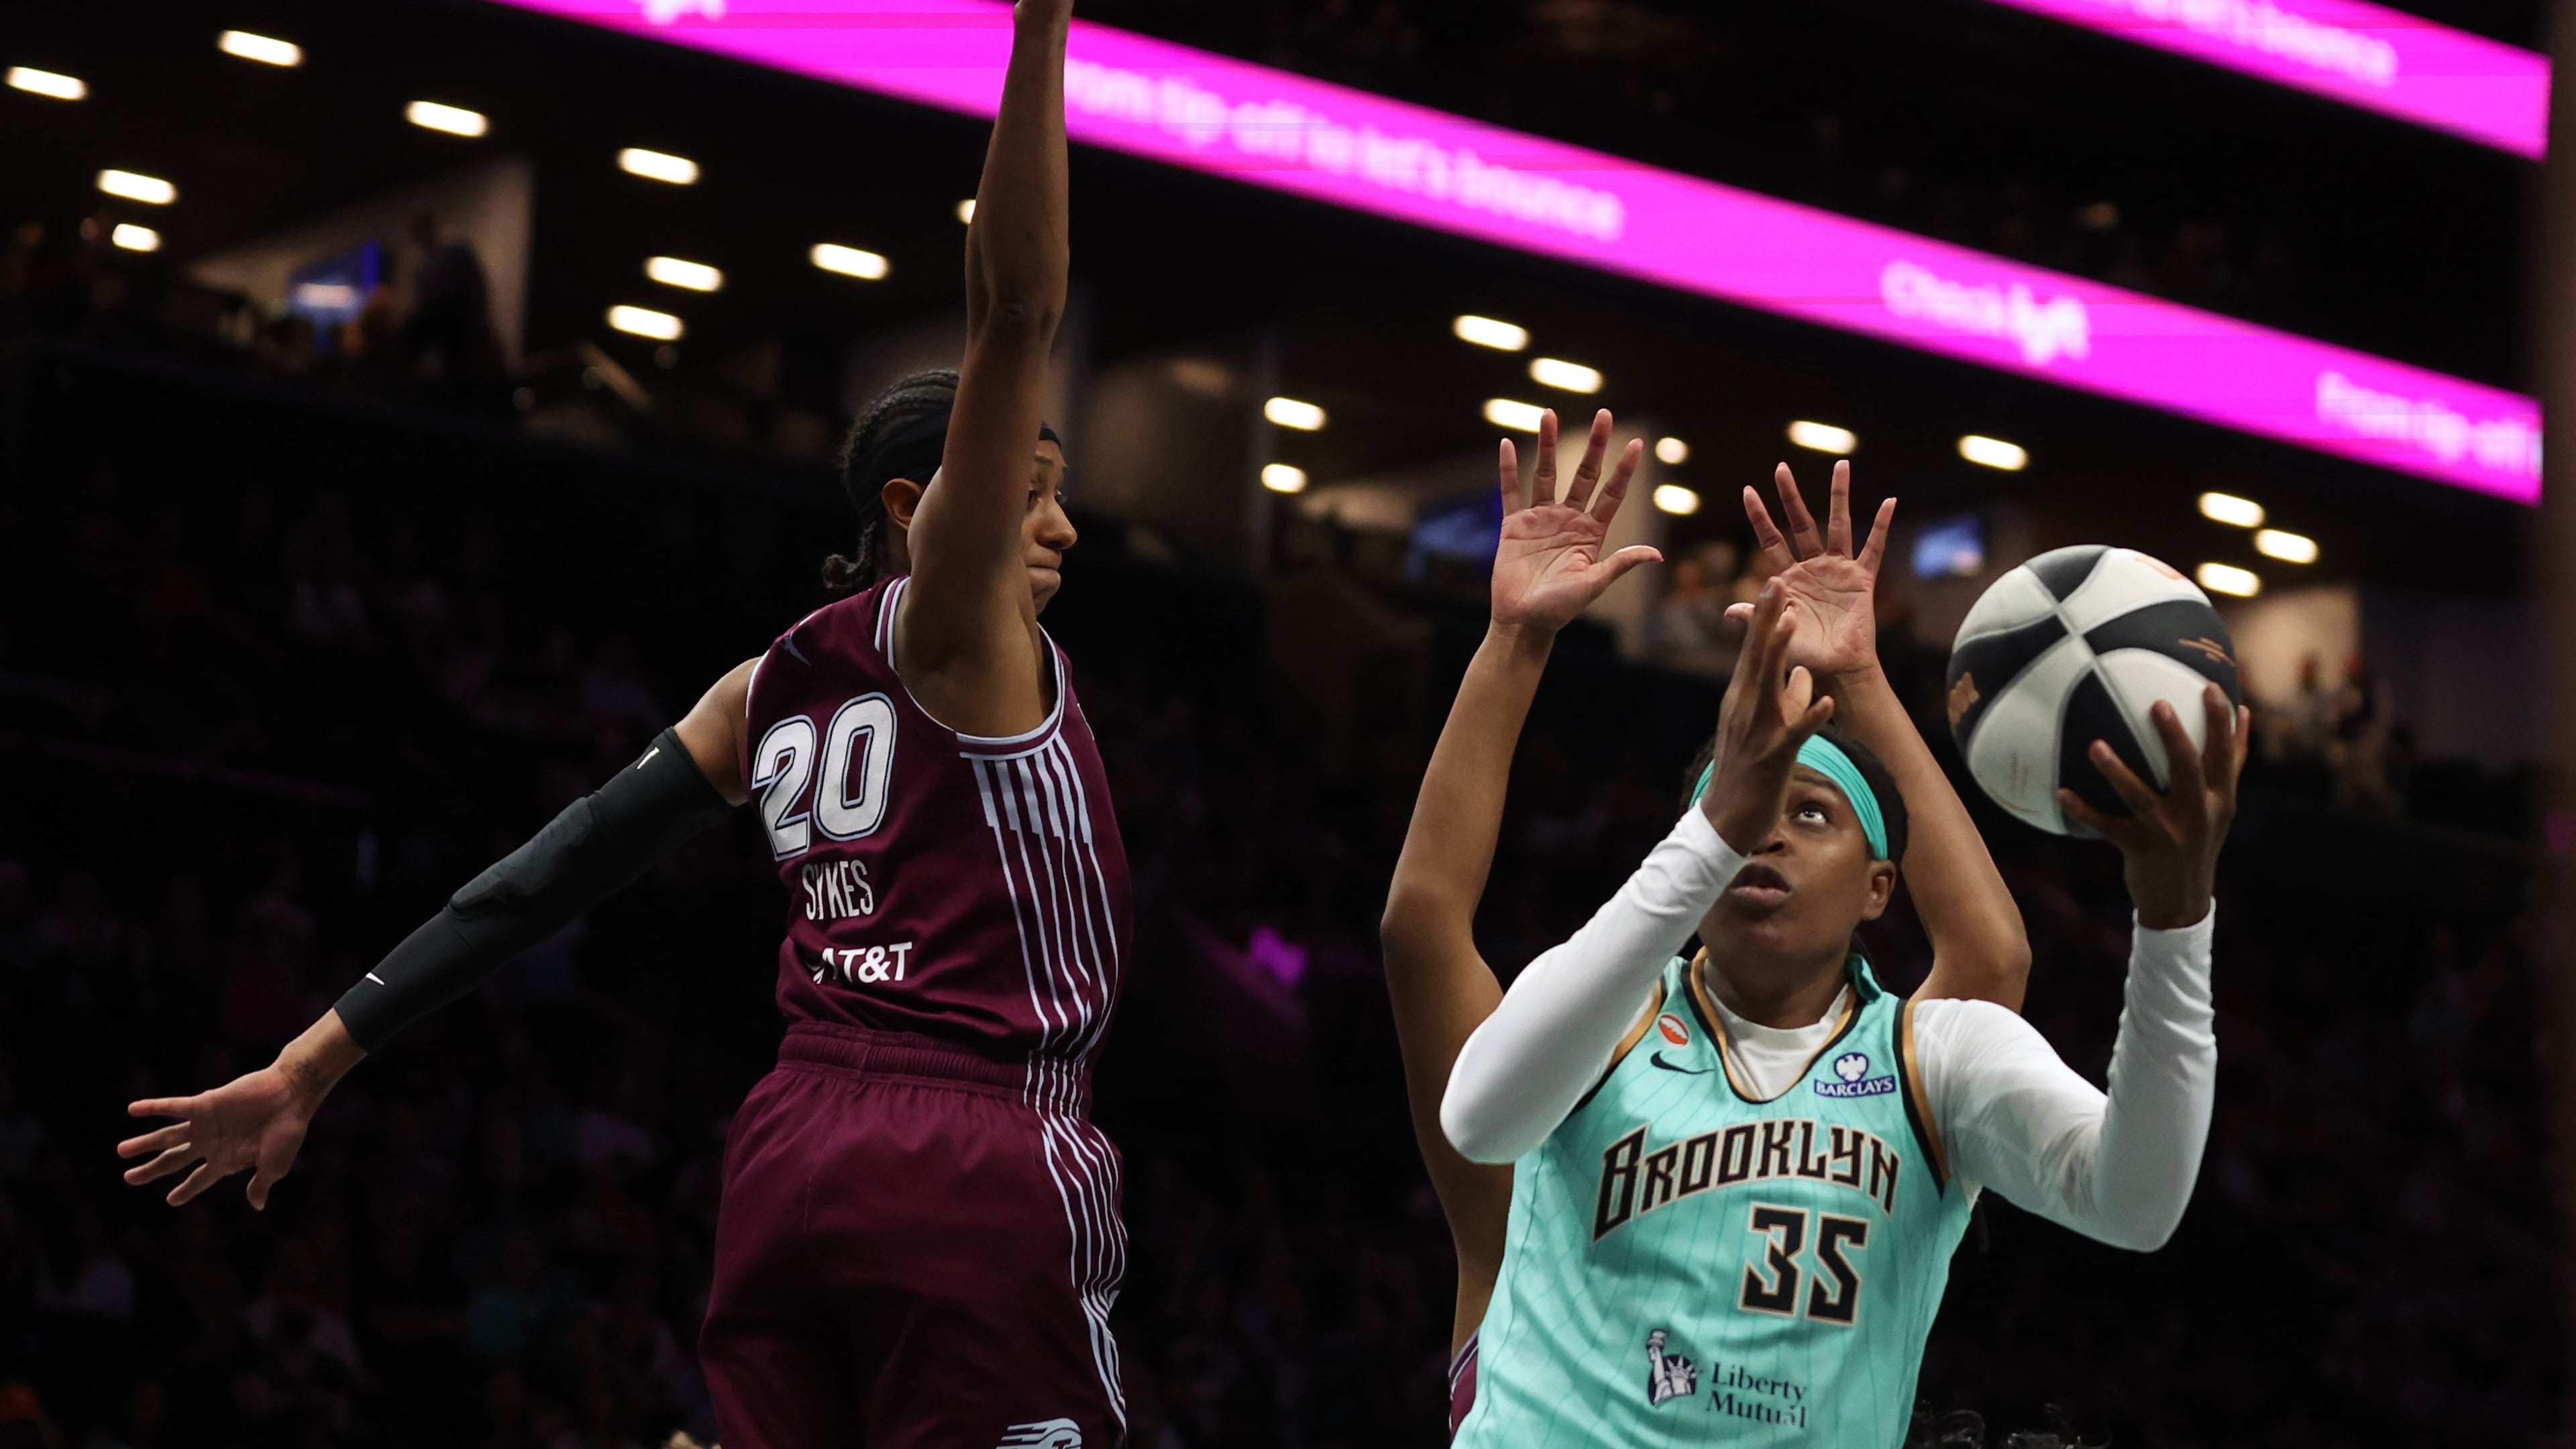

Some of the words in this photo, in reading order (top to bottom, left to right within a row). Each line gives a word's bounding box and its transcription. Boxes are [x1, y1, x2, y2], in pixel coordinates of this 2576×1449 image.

[751, 691, 898, 861] 20
[802, 859, 873, 920] SYKES
[812, 941, 912, 984] AT&T
[1815, 1077, 1894, 1097] BARCLAYS
[1593, 1117, 1901, 1244] BROOKLYN
[1739, 1201, 1870, 1326] 35
[1706, 1390, 1807, 1428] Mutual
[1711, 1362, 1807, 1405] Liberty
